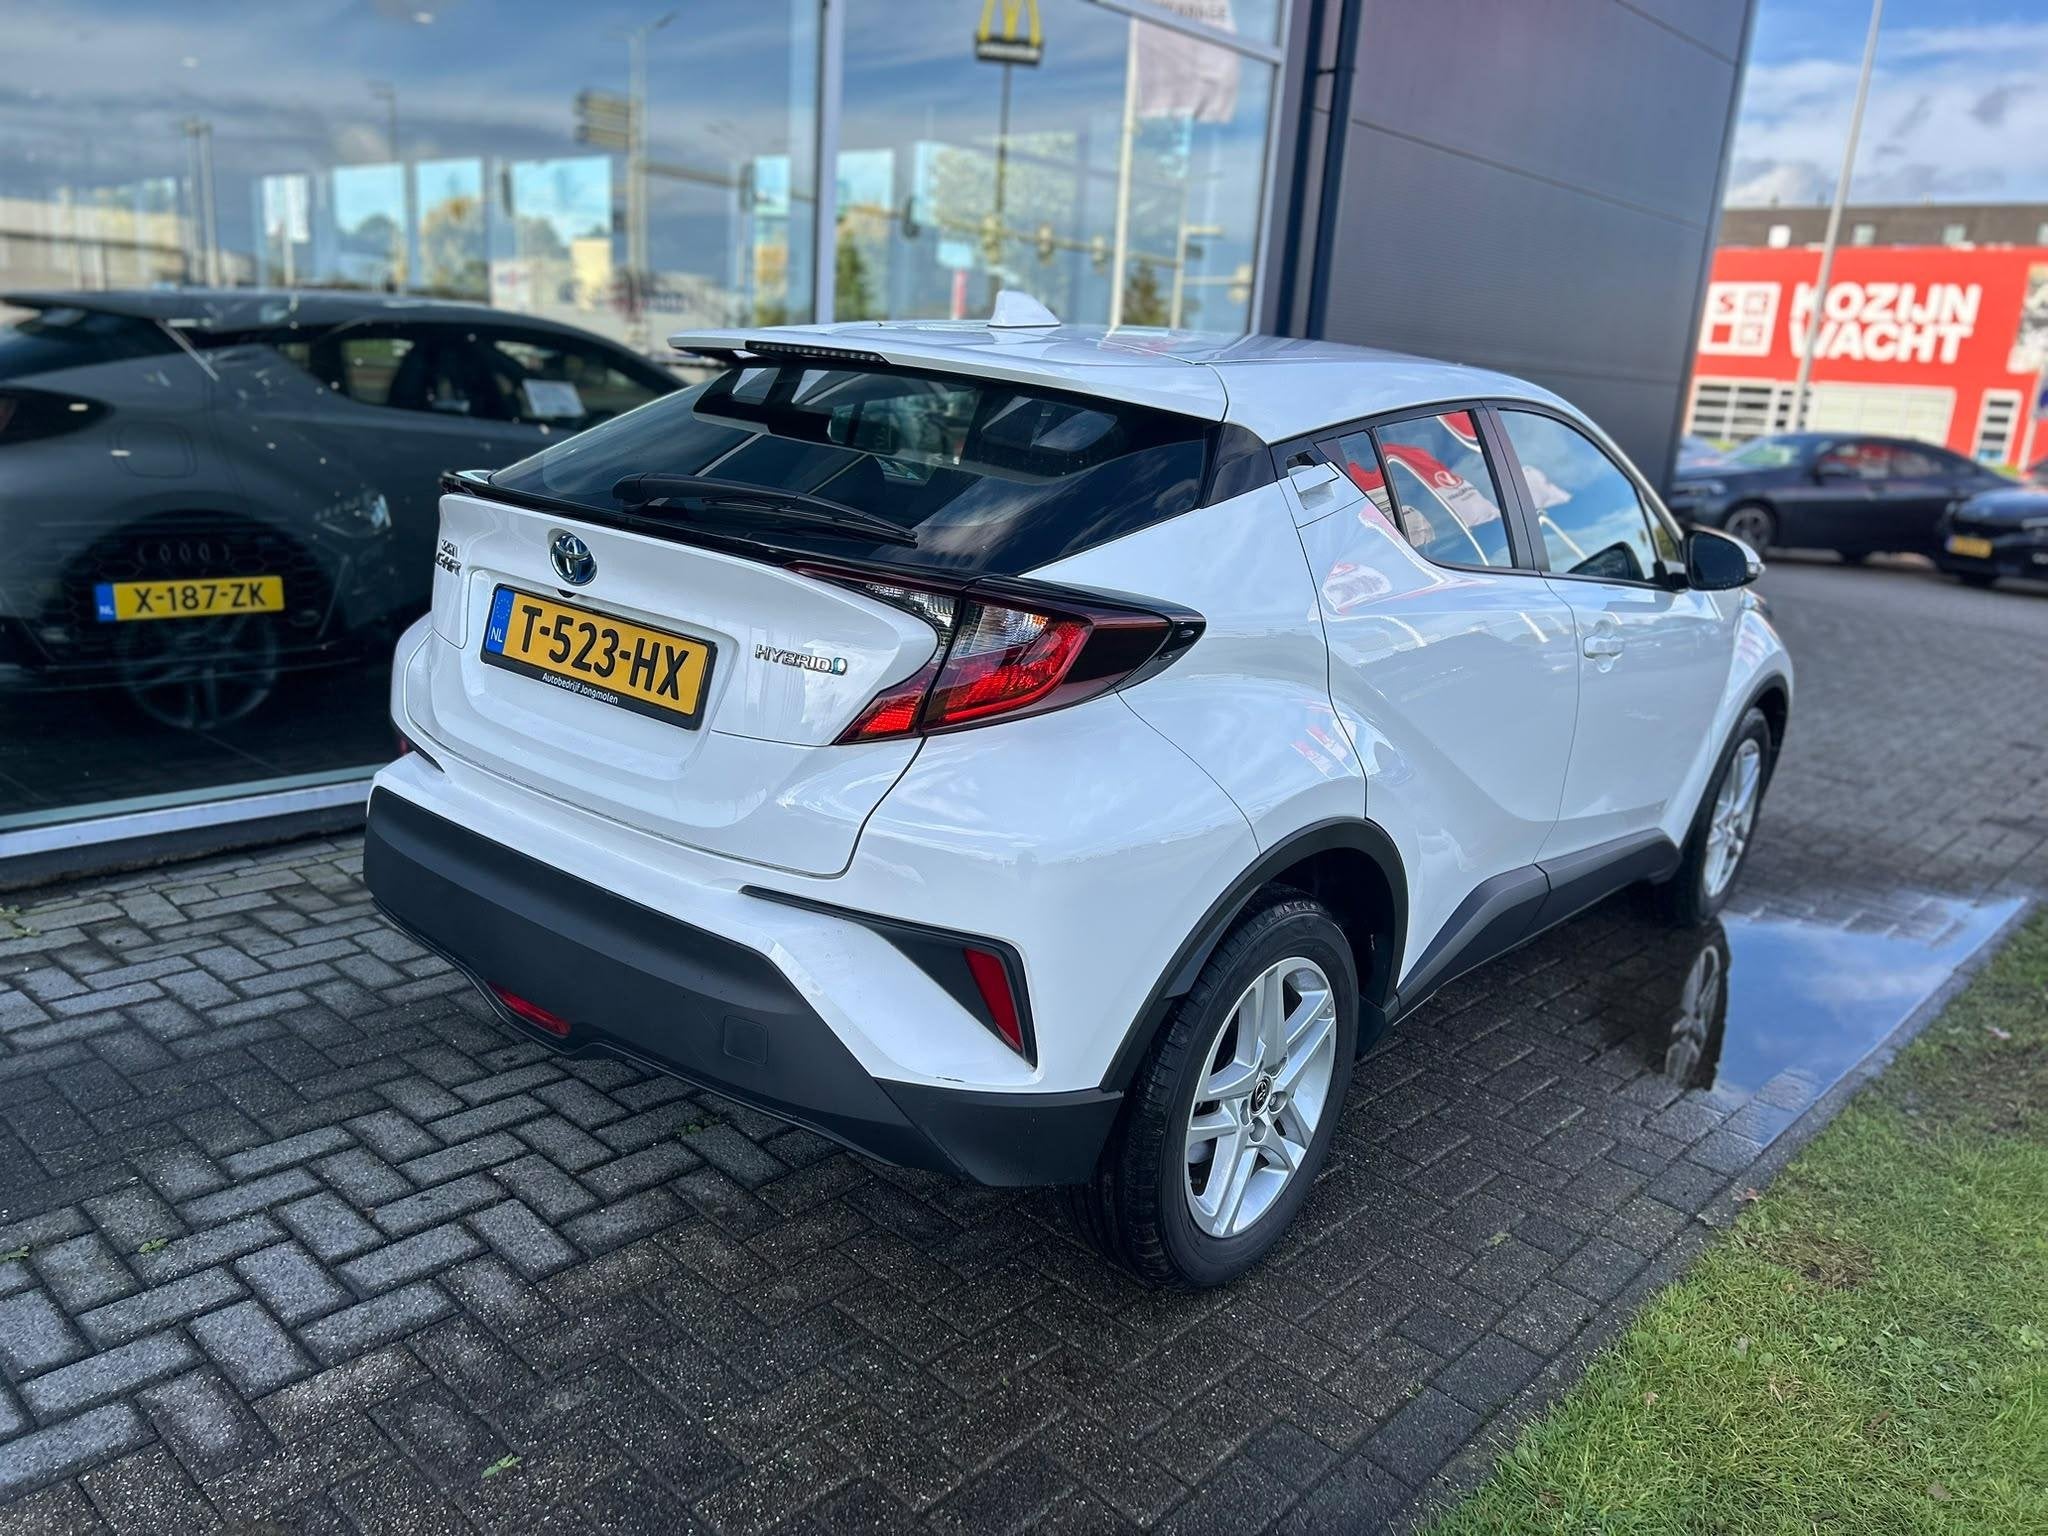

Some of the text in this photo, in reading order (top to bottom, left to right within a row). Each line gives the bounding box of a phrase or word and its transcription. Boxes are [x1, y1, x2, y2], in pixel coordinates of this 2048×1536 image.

[1790, 281, 1983, 326] KOZIJN
[1788, 319, 1974, 364] WACHT
[133, 582, 267, 613] X-187-ZK
[489, 625, 503, 644] NL
[521, 604, 690, 701] T-523-HX
[754, 643, 832, 673] HYBRID
[541, 672, 619, 705] Autobedrijf Jongmolen
